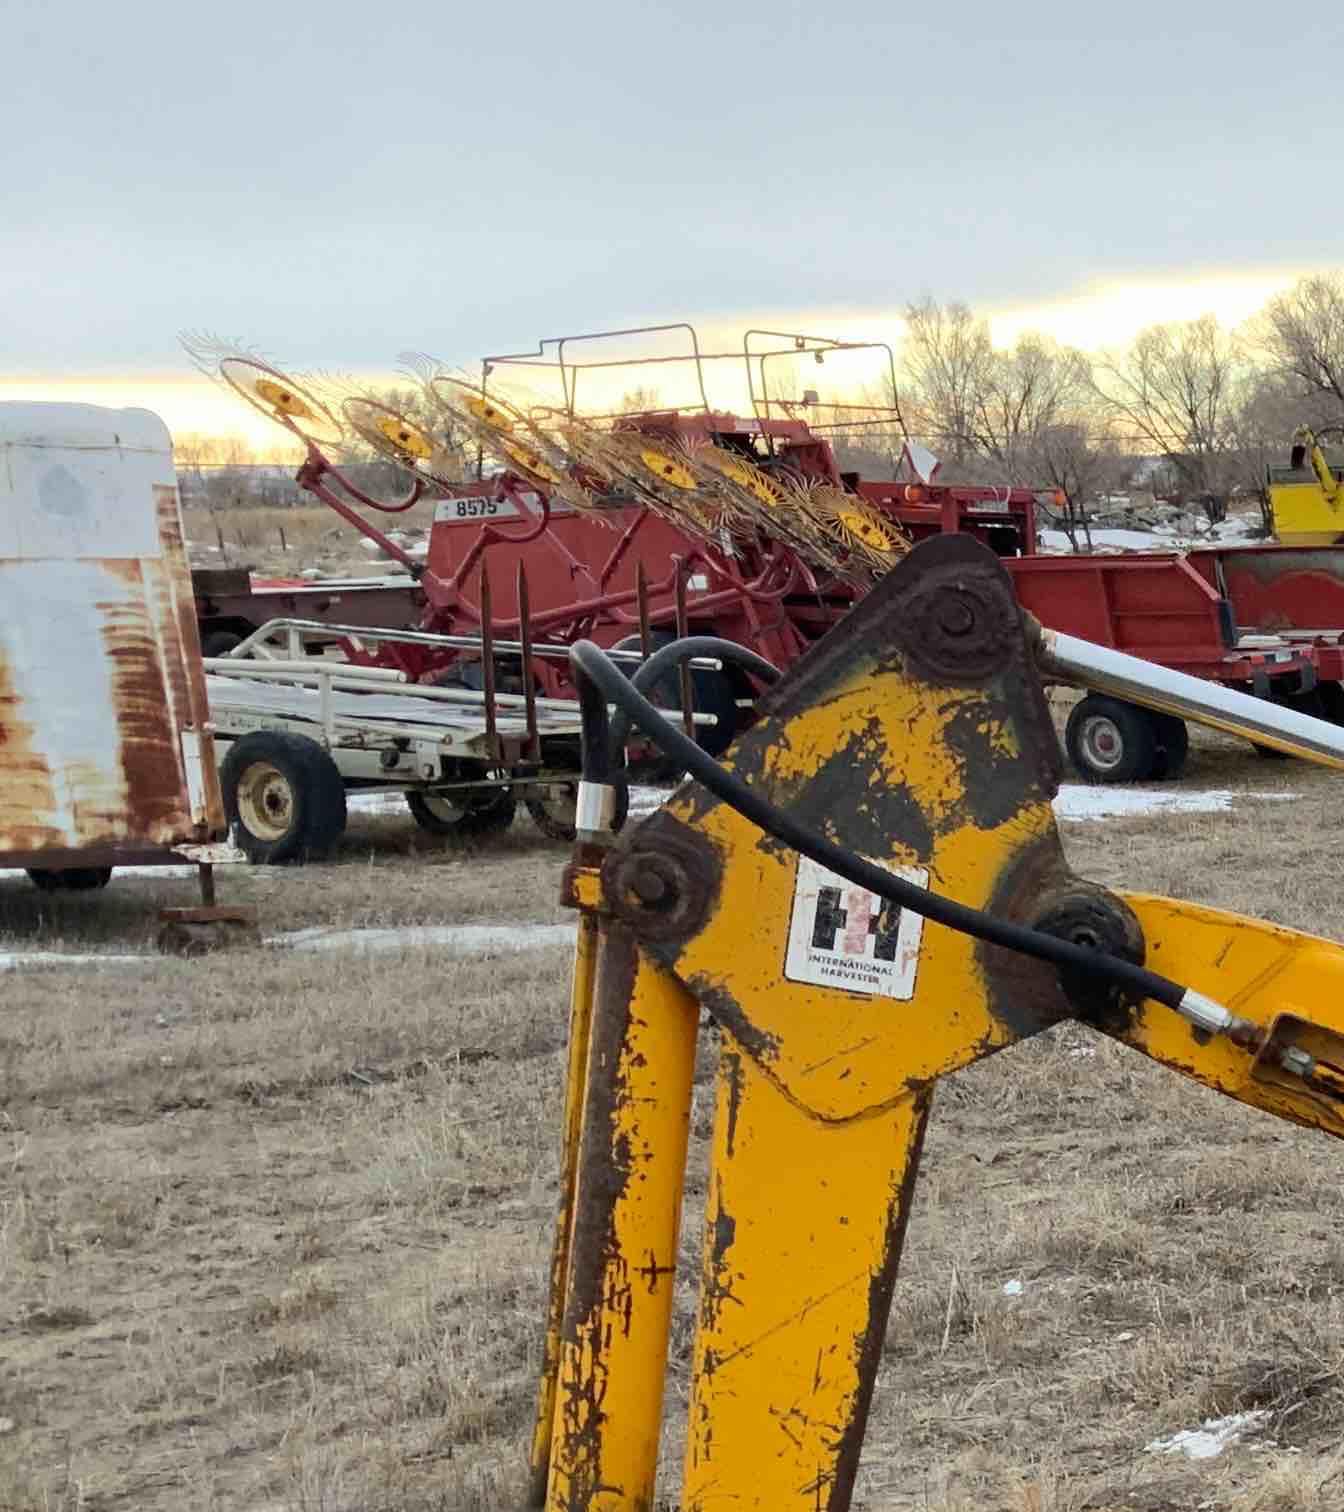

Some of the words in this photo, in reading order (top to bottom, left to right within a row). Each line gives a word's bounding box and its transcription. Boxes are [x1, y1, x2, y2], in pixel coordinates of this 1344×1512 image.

[456, 498, 498, 517] 8575
[808, 954, 895, 976] INTERNATIONAL
[820, 966, 881, 985] HARVESTER
